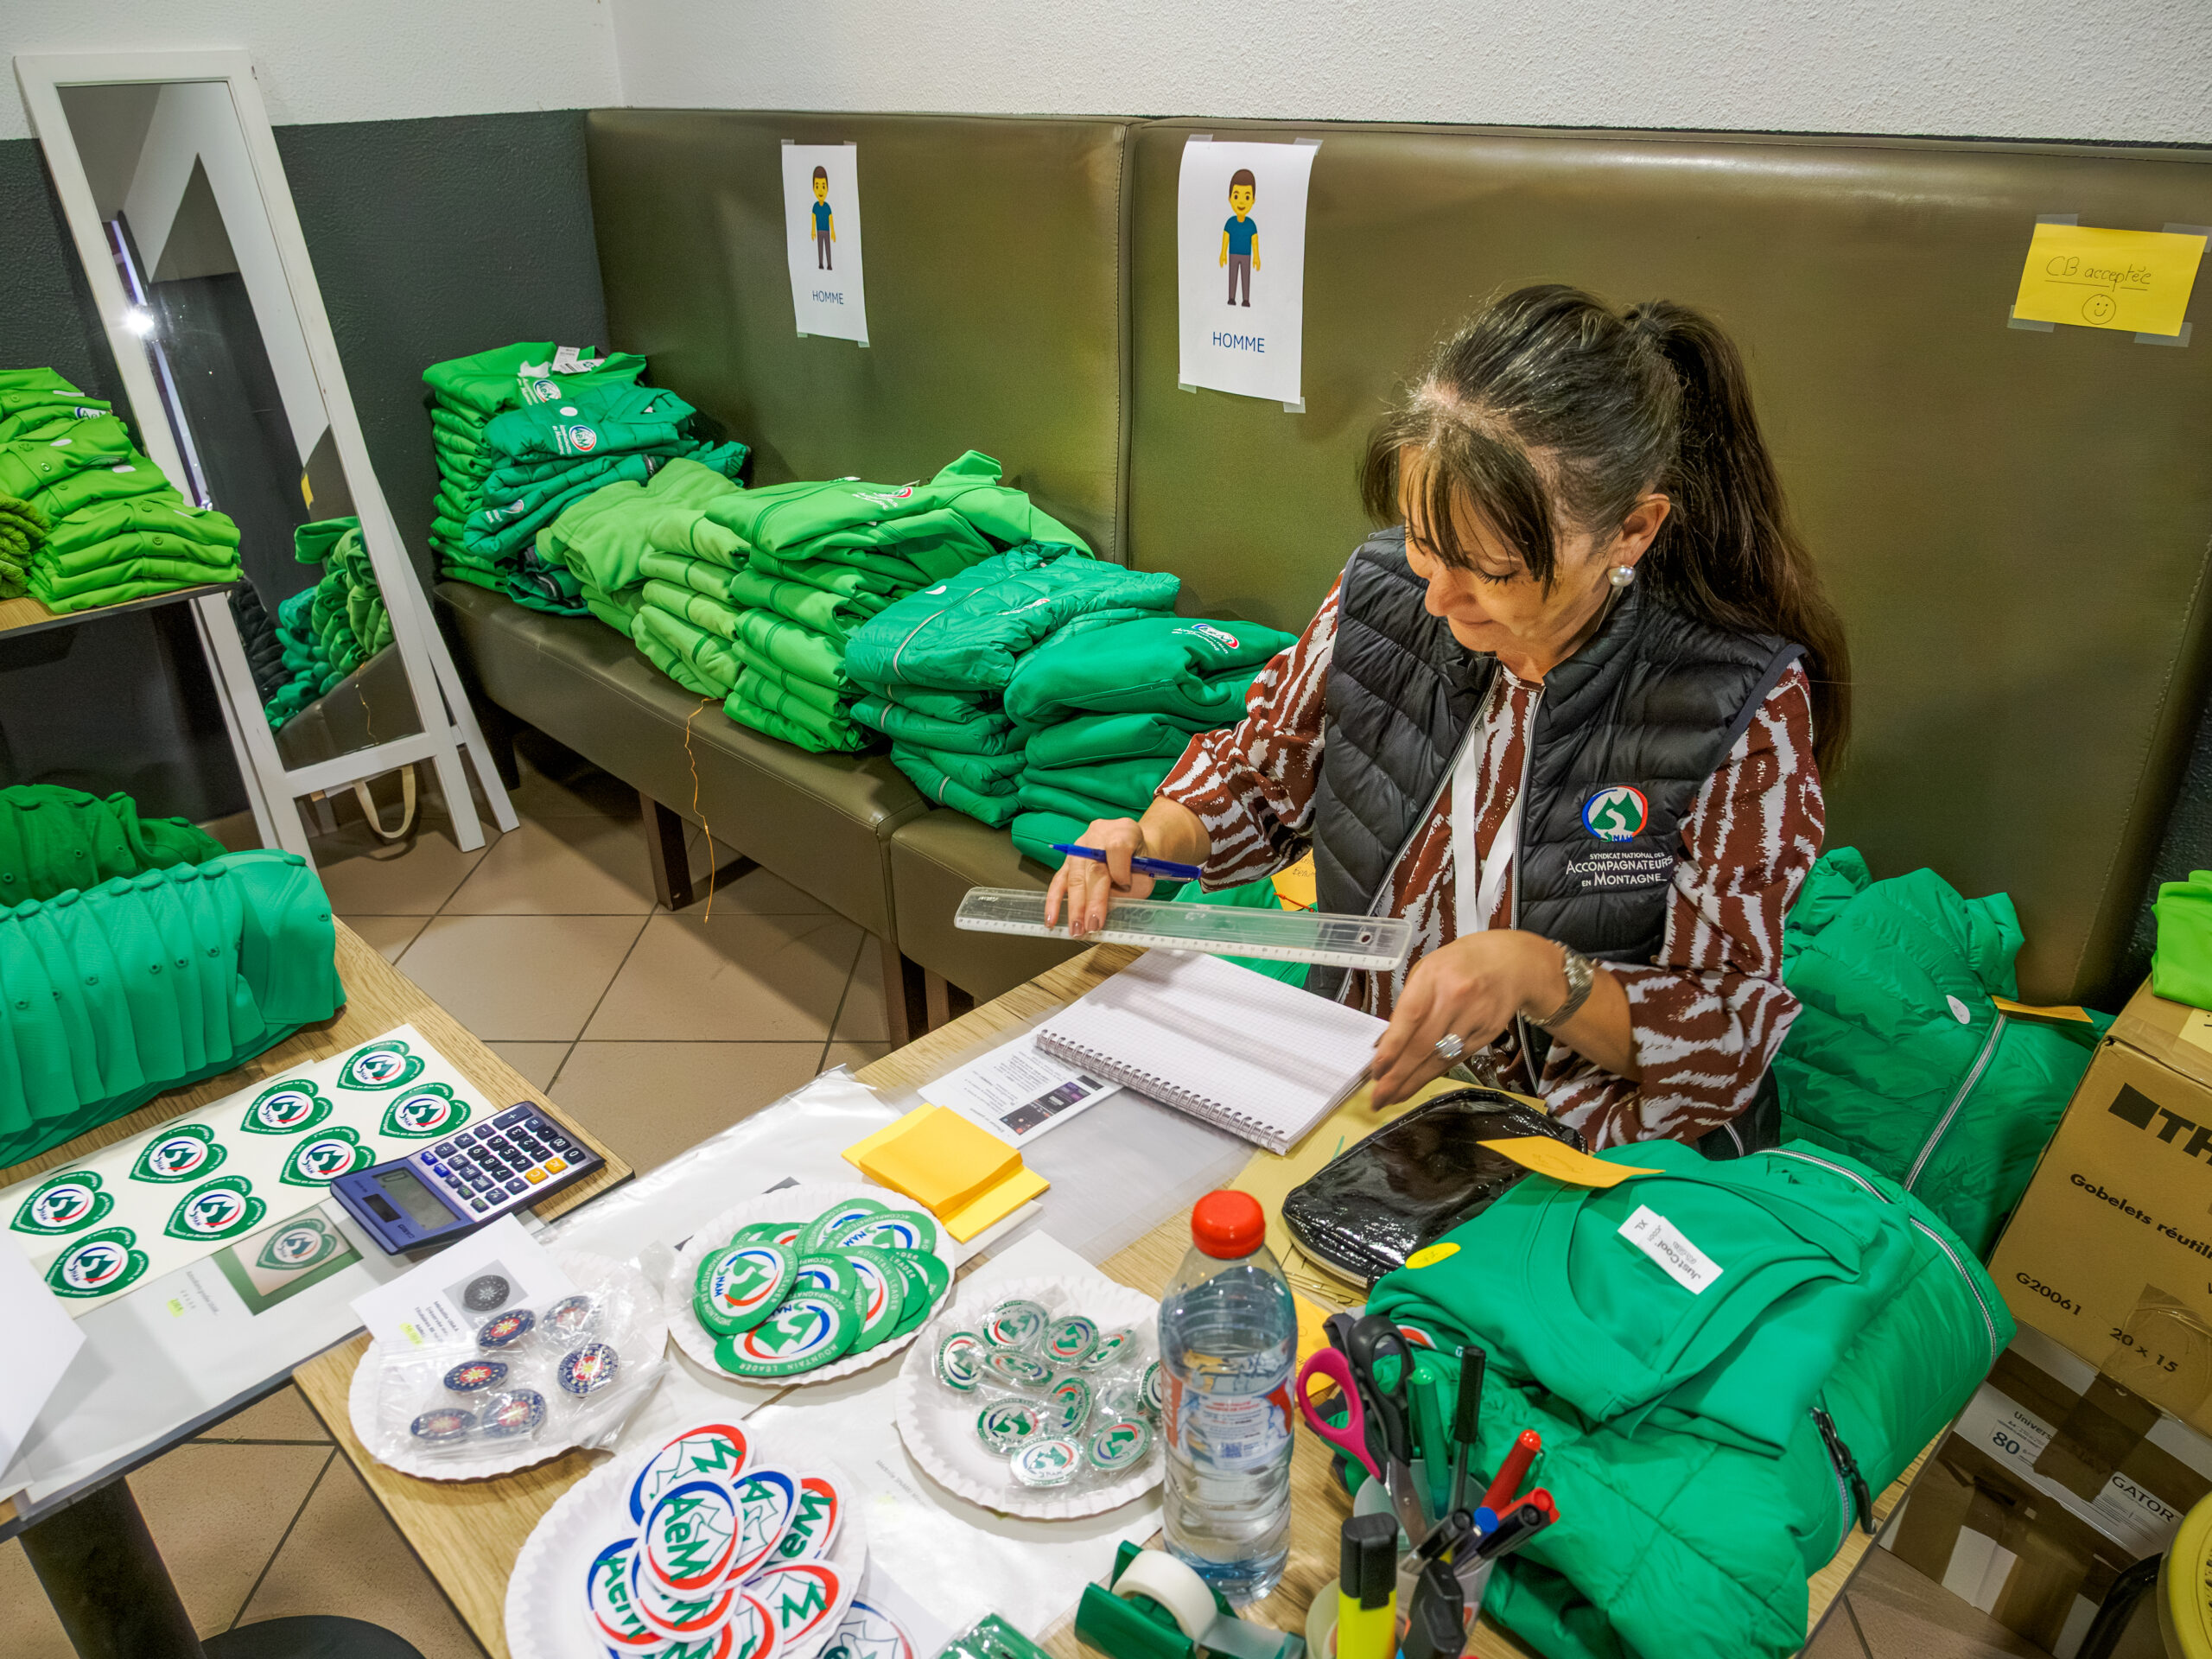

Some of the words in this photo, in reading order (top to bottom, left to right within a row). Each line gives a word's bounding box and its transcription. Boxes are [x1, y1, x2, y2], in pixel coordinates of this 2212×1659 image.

[2046, 256, 2080, 276] CB
[2084, 264, 2152, 293] acceptée
[812, 290, 843, 305] HOMME
[1212, 332, 1265, 353] HOMME
[1634, 1219, 1649, 1230] XL
[2070, 1173, 2152, 1225] Gobelets
[2157, 1223, 2212, 1261] réutili
[889, 1255, 917, 1279] LEADER
[2016, 1272, 2082, 1316] G20061
[2109, 1327, 2134, 1346] 20
[2156, 1354, 2179, 1373] 15
[2013, 1410, 2053, 1440] Univers
[1992, 1431, 2021, 1455] 80
[2111, 1474, 2176, 1523] GATOR
[662, 1497, 712, 1582] AeM
